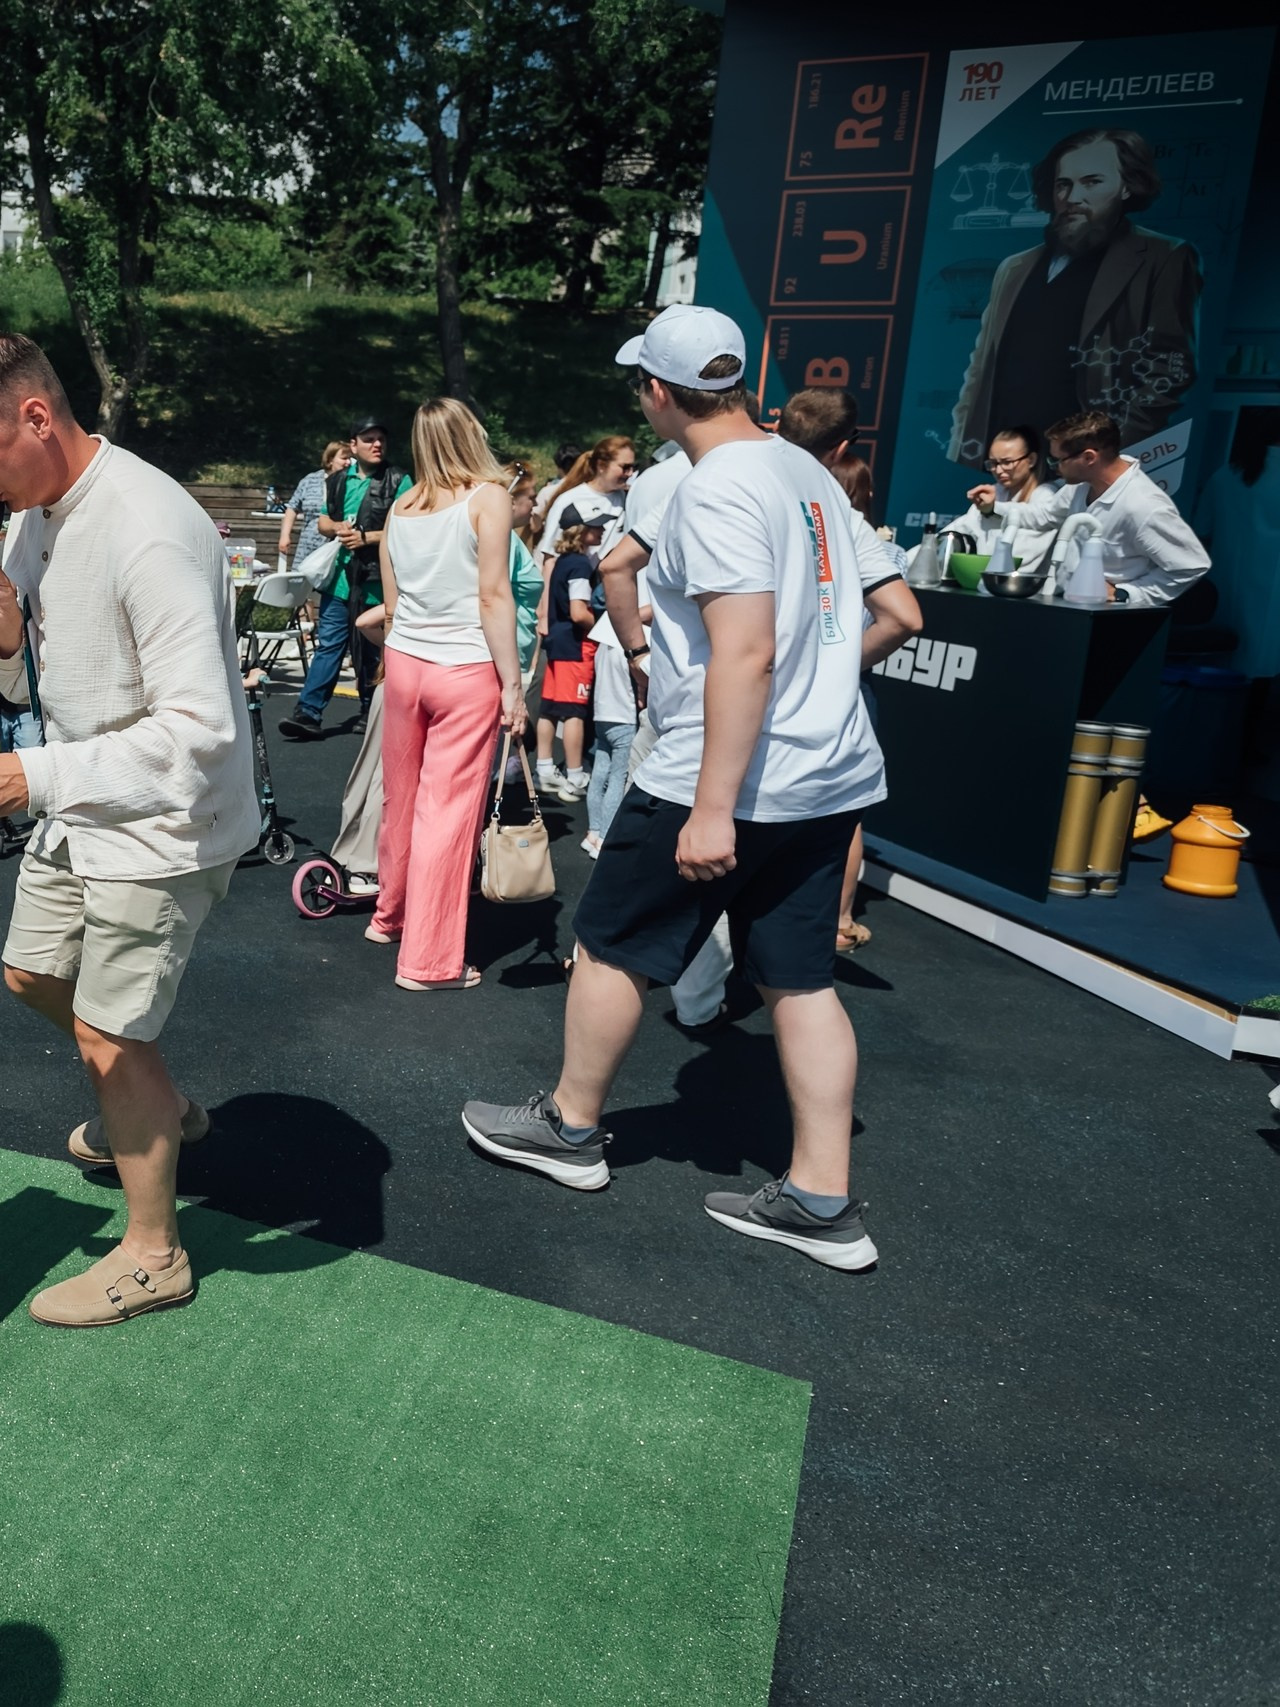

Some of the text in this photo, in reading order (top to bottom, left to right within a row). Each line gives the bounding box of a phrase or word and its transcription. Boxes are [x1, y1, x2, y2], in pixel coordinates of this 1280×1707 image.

[962, 61, 1004, 86] 190
[1044, 71, 1215, 102] МЕНДЕЛЕЕВ
[959, 86, 1001, 102] ЛЕТ
[834, 84, 887, 150] Re
[894, 90, 911, 141] Rhenium
[799, 151, 812, 168] 75
[792, 201, 806, 238] 238.03
[820, 230, 868, 265] U
[876, 222, 893, 271] Uranium
[784, 277, 797, 294] 92
[777, 326, 790, 361] 10.811
[805, 356, 850, 387] B
[860, 356, 875, 389] Boron
[1134, 442, 1178, 465] ель
[811, 507, 836, 639] БЛИЗОК КАЖДОМУ
